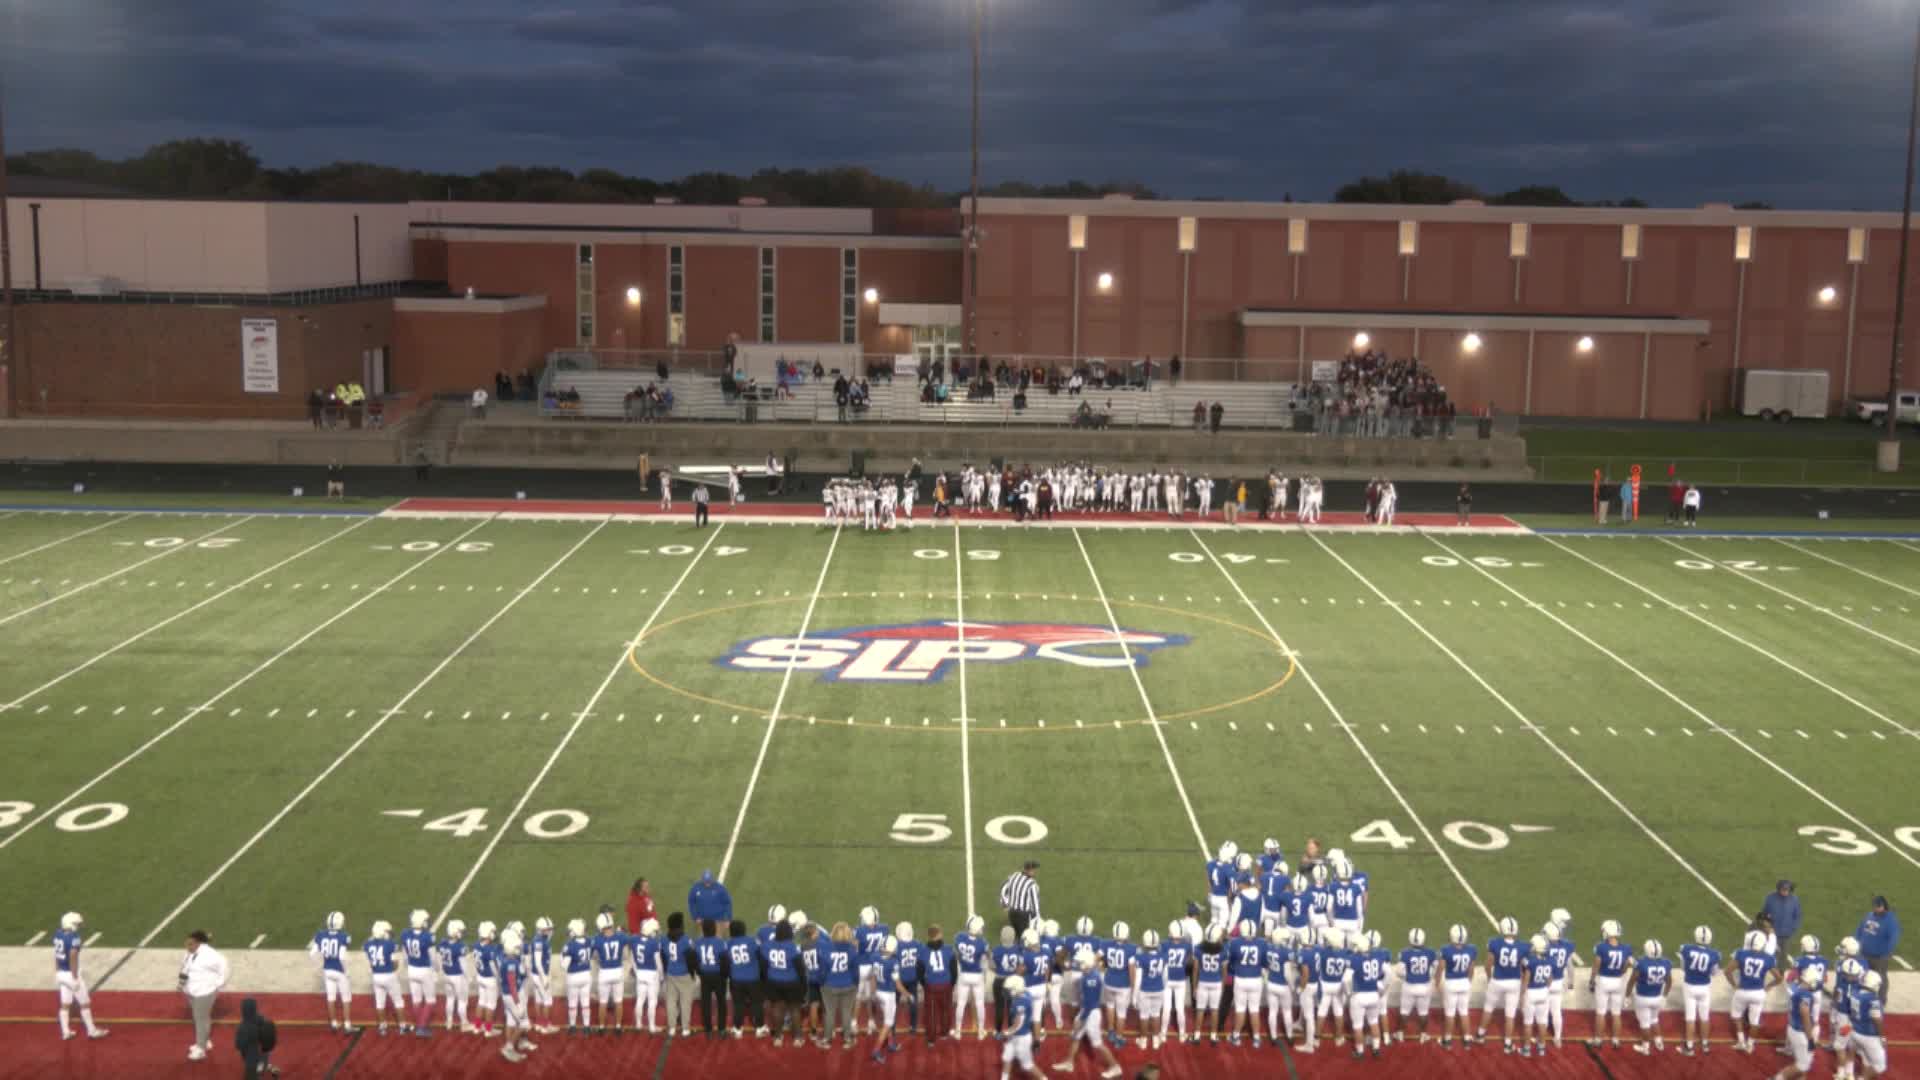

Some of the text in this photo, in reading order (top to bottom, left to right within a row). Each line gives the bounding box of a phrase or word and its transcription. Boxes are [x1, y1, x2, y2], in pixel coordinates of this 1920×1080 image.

[731, 638, 1027, 679] SLP
[1292, 899, 1301, 916] 3
[604, 941, 620, 960] 17
[637, 944, 645, 964] 5
[669, 942, 678, 962] 9
[700, 944, 716, 966] 14
[731, 944, 750, 964] 66
[1107, 948, 1125, 969] 50
[1240, 946, 1258, 966] 73
[1500, 948, 1518, 968] 64
[1608, 950, 1623, 970] 71
[830, 952, 848, 973] 72
[930, 951, 944, 972] 41
[1326, 958, 1345, 976] 63
[1690, 950, 1710, 972] 70
[1744, 957, 1765, 978] 67
